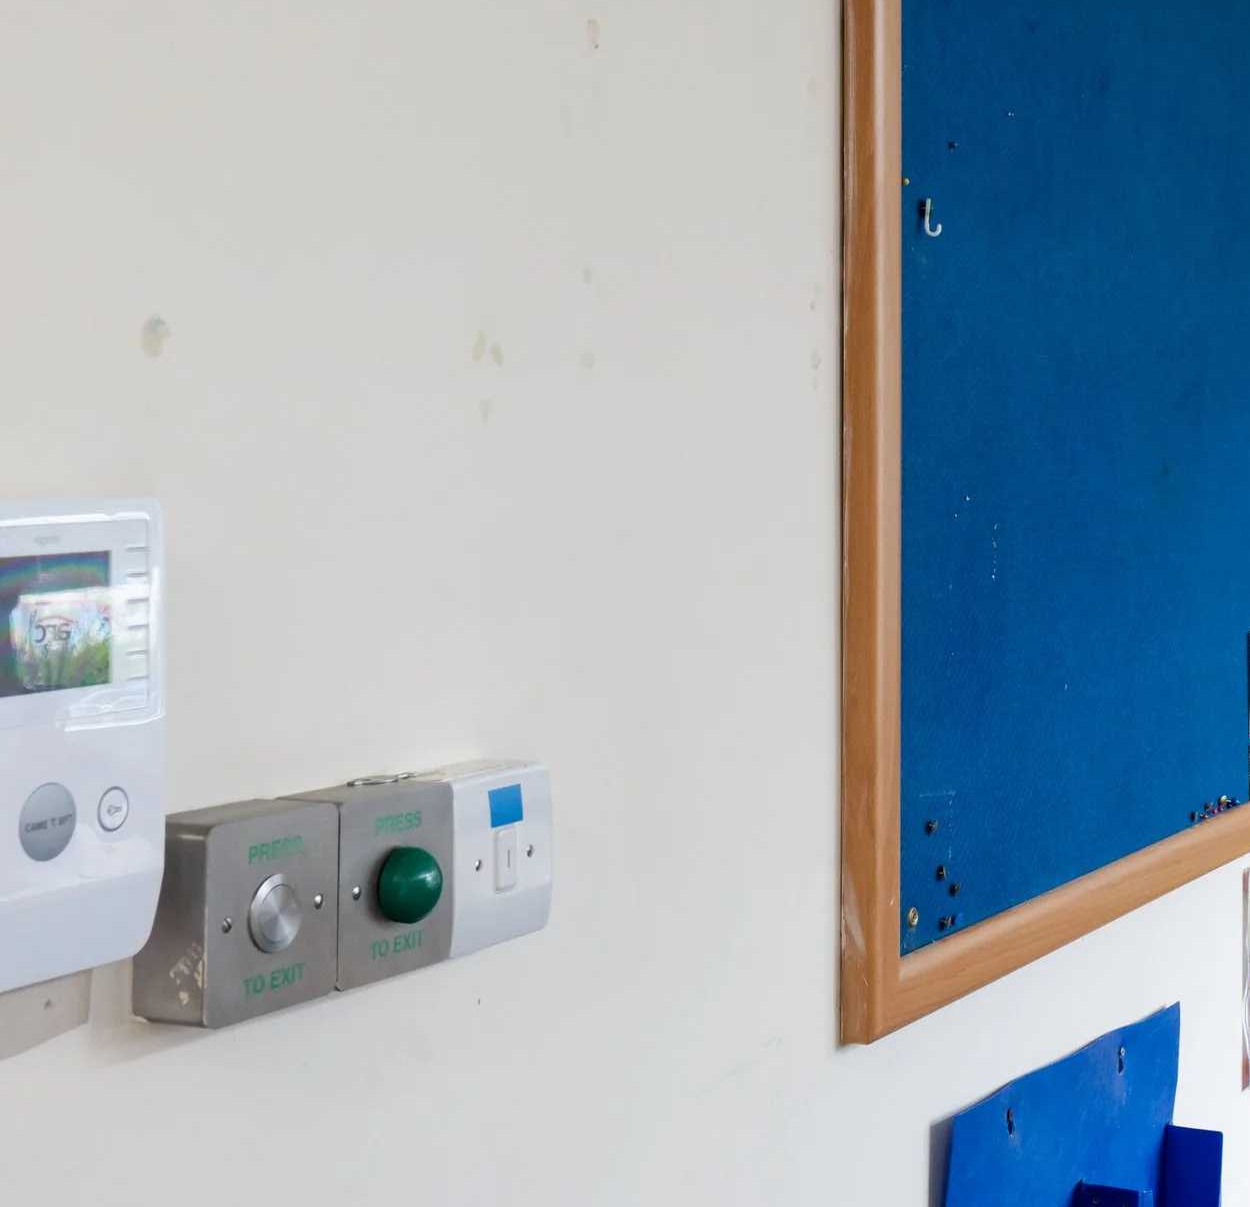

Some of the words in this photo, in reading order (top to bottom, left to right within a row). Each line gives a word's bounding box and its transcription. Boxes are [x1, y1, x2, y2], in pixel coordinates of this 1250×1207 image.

[375, 809, 423, 836] PRESS
[370, 938, 390, 961] TO
[393, 928, 425, 955] EXIT
[242, 974, 267, 1000] TO
[269, 962, 305, 991] EXIT
